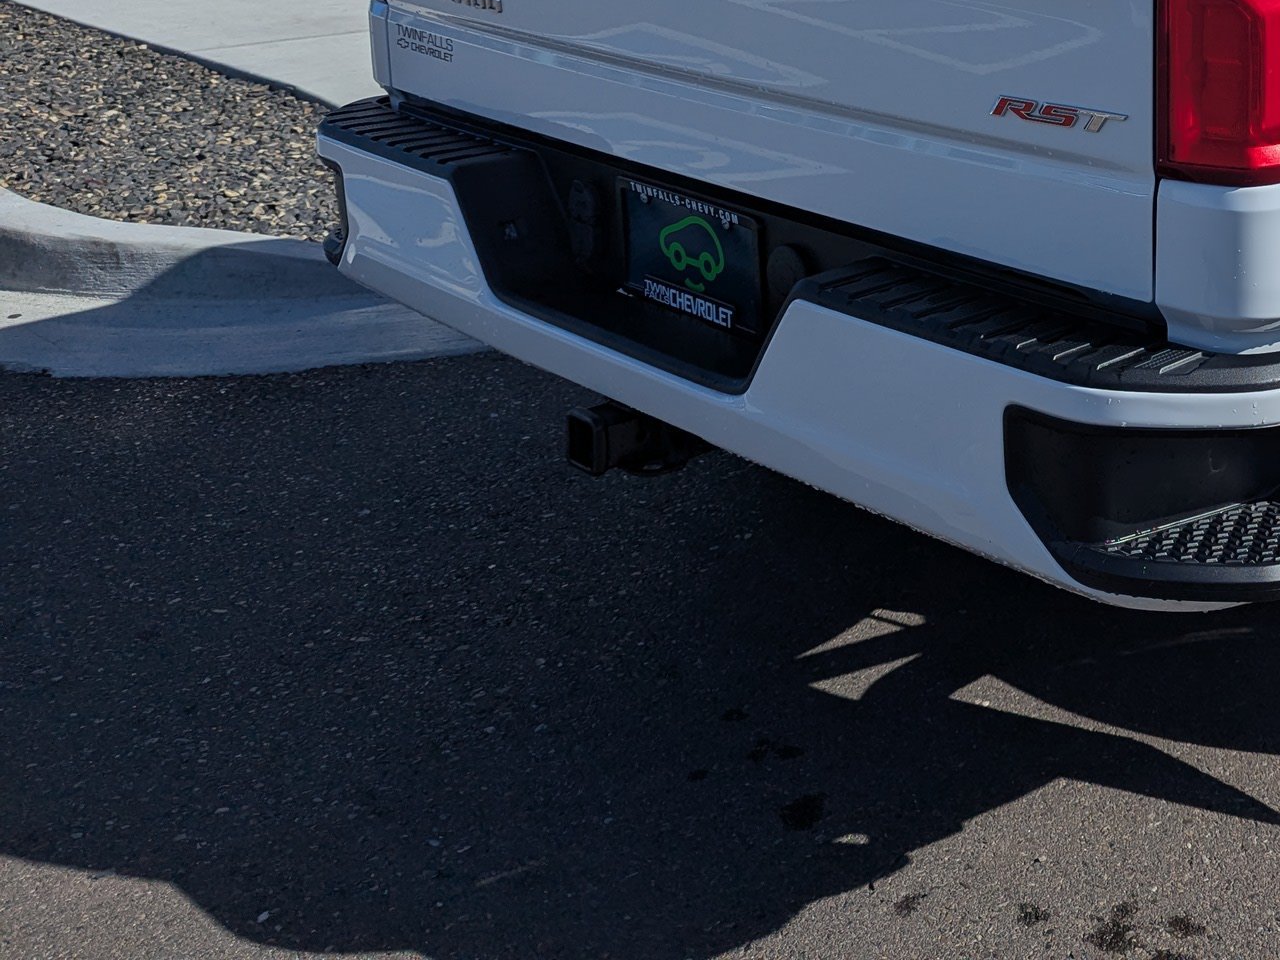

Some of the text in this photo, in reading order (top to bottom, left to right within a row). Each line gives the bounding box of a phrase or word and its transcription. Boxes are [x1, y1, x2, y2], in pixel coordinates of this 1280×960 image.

[410, 43, 454, 63] CHEVROLET
[990, 94, 1129, 132] RST
[630, 181, 739, 224] TWINFALLS-CHEVY.COM
[644, 279, 670, 297] TWIN
[644, 289, 671, 305] FALLS
[669, 289, 733, 328] CHEVROLET
